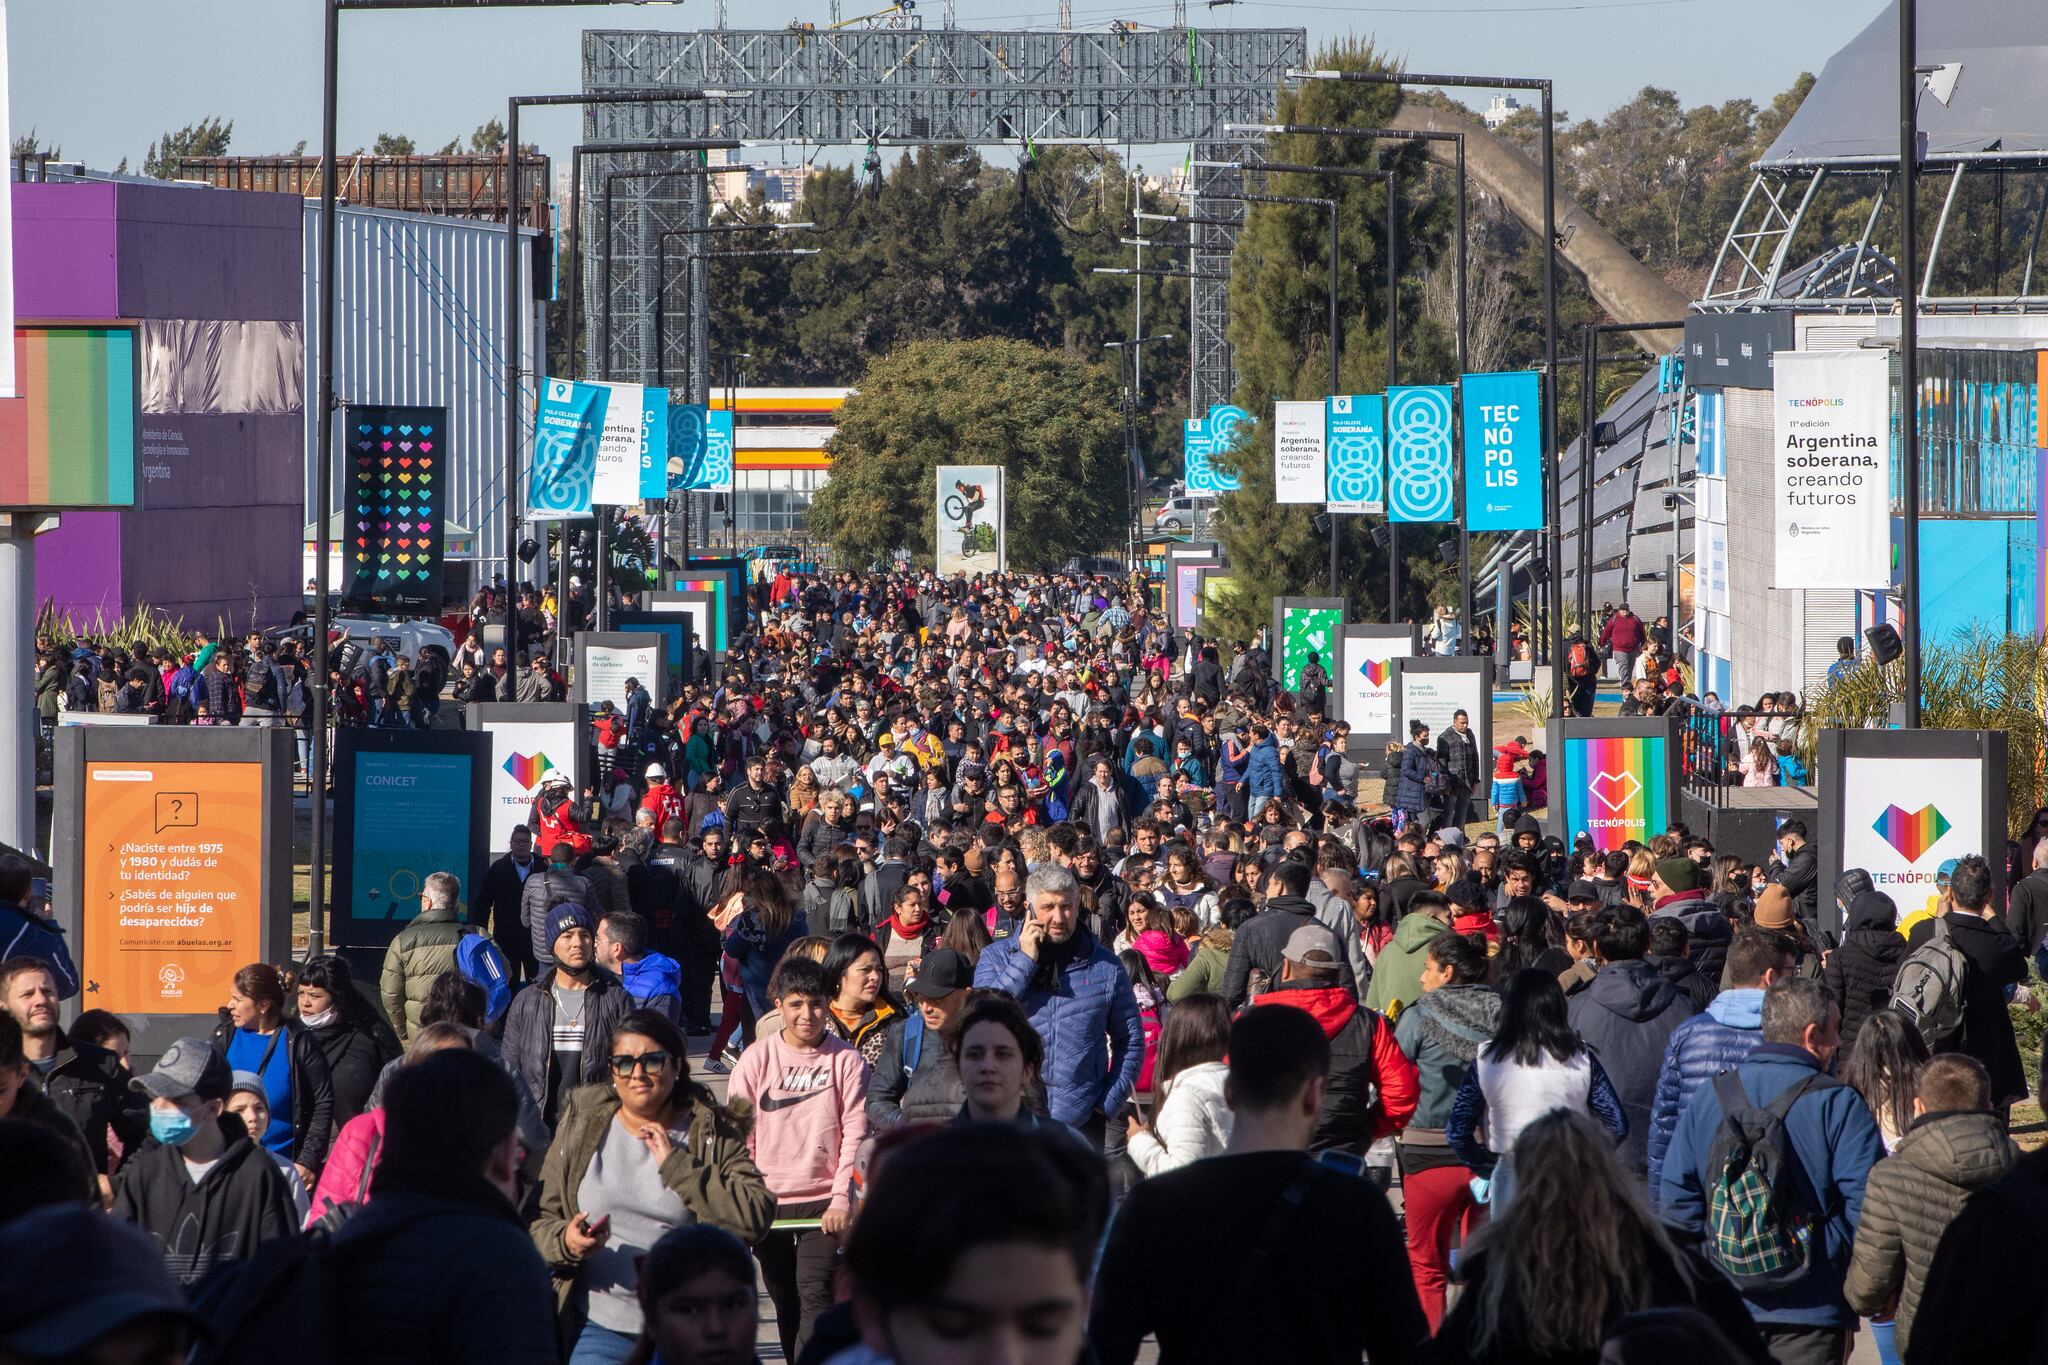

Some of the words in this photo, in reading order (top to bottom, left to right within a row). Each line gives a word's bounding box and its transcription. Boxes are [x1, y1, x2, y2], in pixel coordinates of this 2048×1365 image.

[1788, 397, 1844, 407] TECNÓPOLIS
[1480, 404, 1520, 423] TEC
[1800, 420, 1830, 428] edición
[1484, 423, 1513, 446] NÓ
[1280, 437, 1320, 446] Argentina
[1786, 433, 1878, 452] Argentina
[1485, 449, 1513, 467] PO
[1787, 453, 1878, 469] soberana,
[1485, 469, 1519, 488] LIS
[1787, 472, 1863, 487] creando
[1787, 491, 1857, 506] futuros
[365, 775, 417, 787] CONICET
[1587, 817, 1646, 828] TECNÓPOLIS
[120, 843, 165, 855] ¿Naciste
[167, 844, 196, 854] entre
[198, 843, 223, 854] 1975
[120, 859, 127, 868] y
[129, 857, 157, 867] 1980
[160, 859, 167, 868] y
[170, 857, 201, 867] dudás
[204, 857, 217, 867] de
[120, 871, 131, 880] tu
[134, 870, 190, 881] identidad?
[1871, 870, 1938, 884] TECNÓPOL
[120, 889, 157, 902] ¿Sabés
[159, 889, 172, 899] de
[175, 889, 214, 902] alguien
[216, 891, 236, 902] que
[120, 903, 154, 915] podría
[157, 904, 173, 913] ser
[176, 903, 196, 915] hijx
[199, 903, 213, 913] de
[120, 916, 205, 929] desaparecidxs?
[177, 939, 232, 947] abuelas.org.ar
